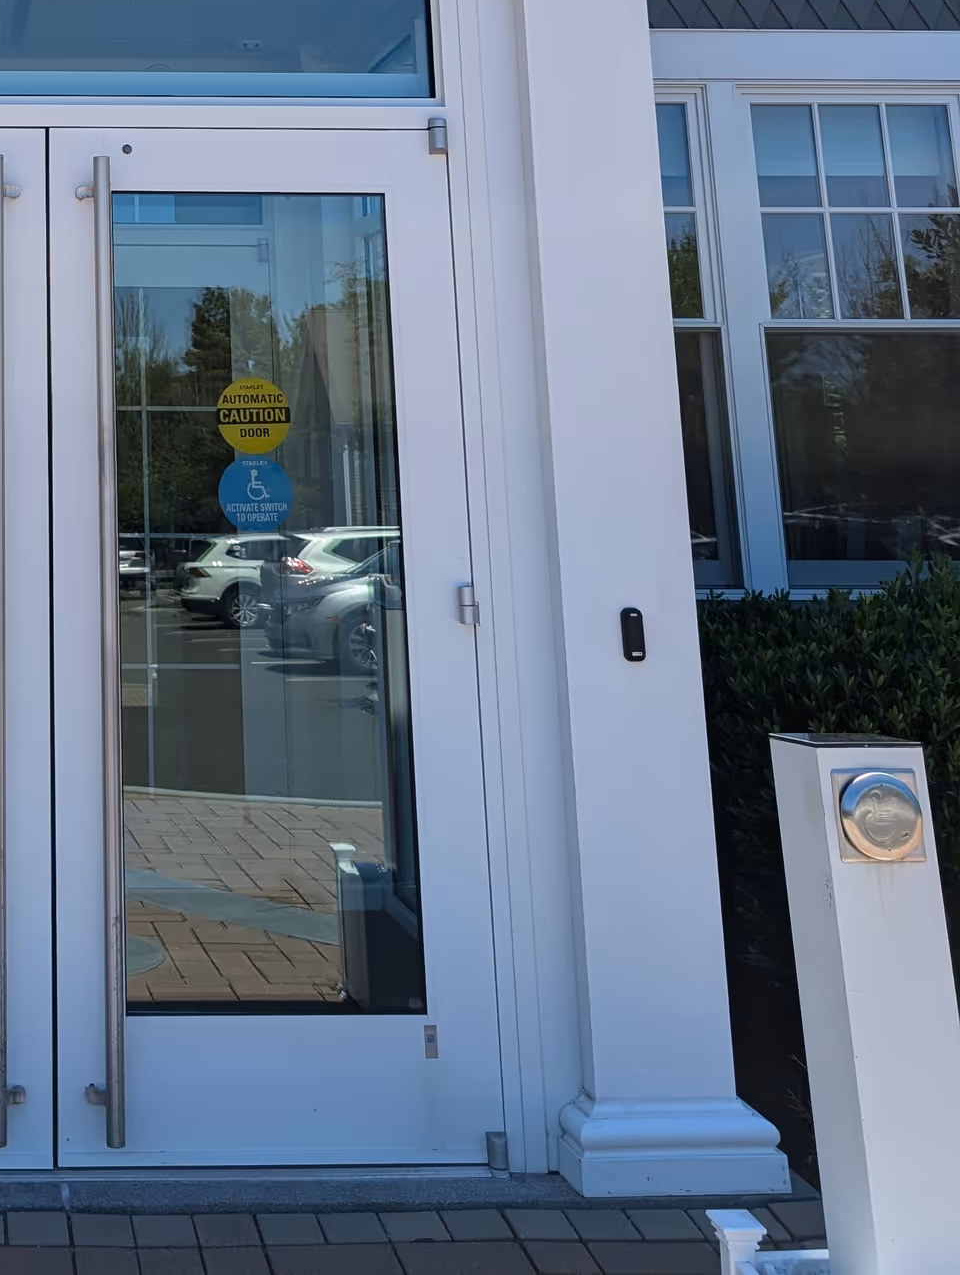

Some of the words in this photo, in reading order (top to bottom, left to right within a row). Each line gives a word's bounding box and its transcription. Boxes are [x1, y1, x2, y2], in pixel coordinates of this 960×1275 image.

[222, 394, 284, 404] AUTOMATIC
[219, 408, 286, 422] CAUTION
[240, 428, 271, 438] DOOR
[226, 503, 259, 512] ACTIVATE
[260, 502, 288, 512] SWITCH
[236, 513, 246, 522] TO
[247, 512, 279, 522] OPERATE
